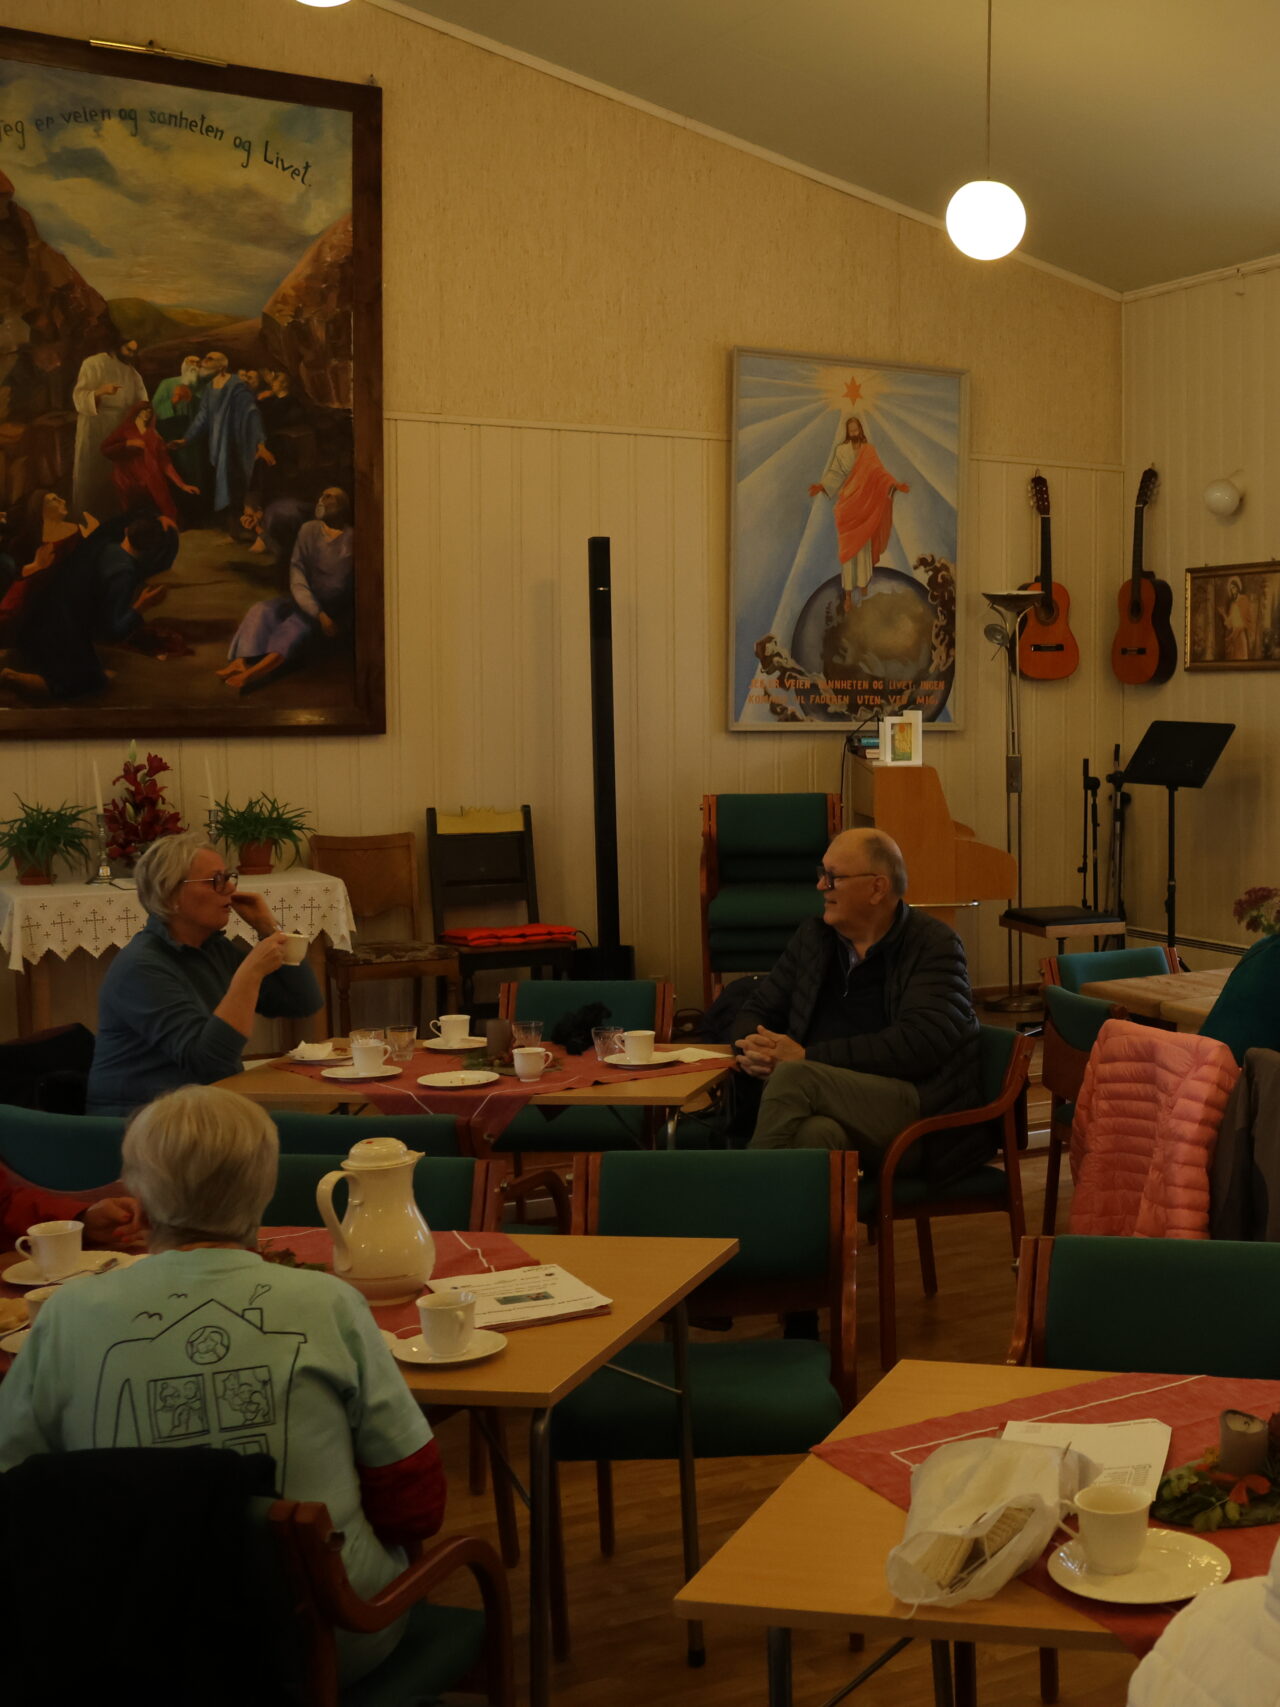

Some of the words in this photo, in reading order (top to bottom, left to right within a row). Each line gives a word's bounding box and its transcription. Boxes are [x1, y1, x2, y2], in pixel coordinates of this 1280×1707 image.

[35, 116, 55, 132] er
[118, 108, 138, 137] og
[233, 135, 252, 168] og
[263, 140, 312, 187] Livet.
[784, 679, 811, 689] VEIEN
[872, 679, 884, 690] OG
[856, 694, 881, 705] UTEN
